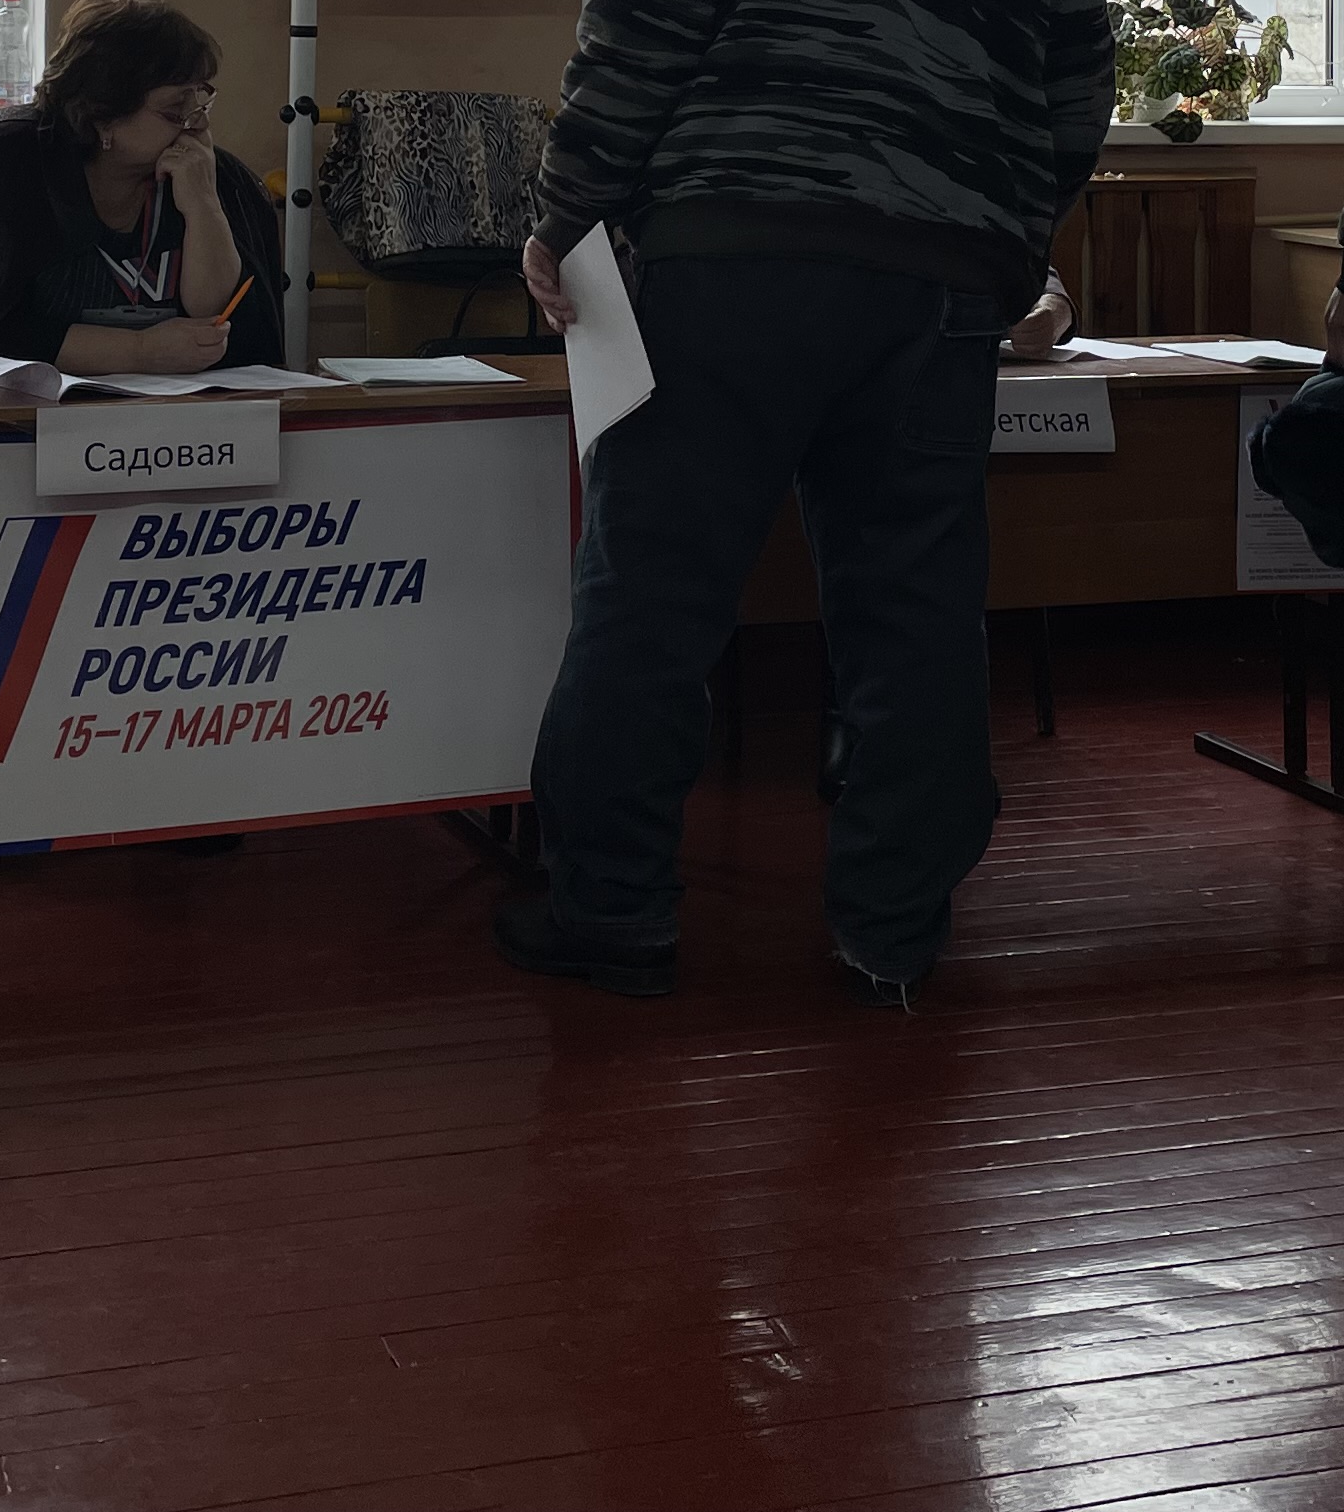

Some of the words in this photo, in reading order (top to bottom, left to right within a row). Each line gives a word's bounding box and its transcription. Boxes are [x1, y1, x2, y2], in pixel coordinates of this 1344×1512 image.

[994, 412, 1090, 433] етская
[83, 440, 236, 476] Садовая
[119, 499, 361, 561] ВЫБОРЫ
[94, 558, 428, 629] ПРЕЗИДЕНТА
[71, 635, 289, 698] РОССИИ
[165, 698, 294, 751] МАРТА
[301, 690, 391, 738] 2024
